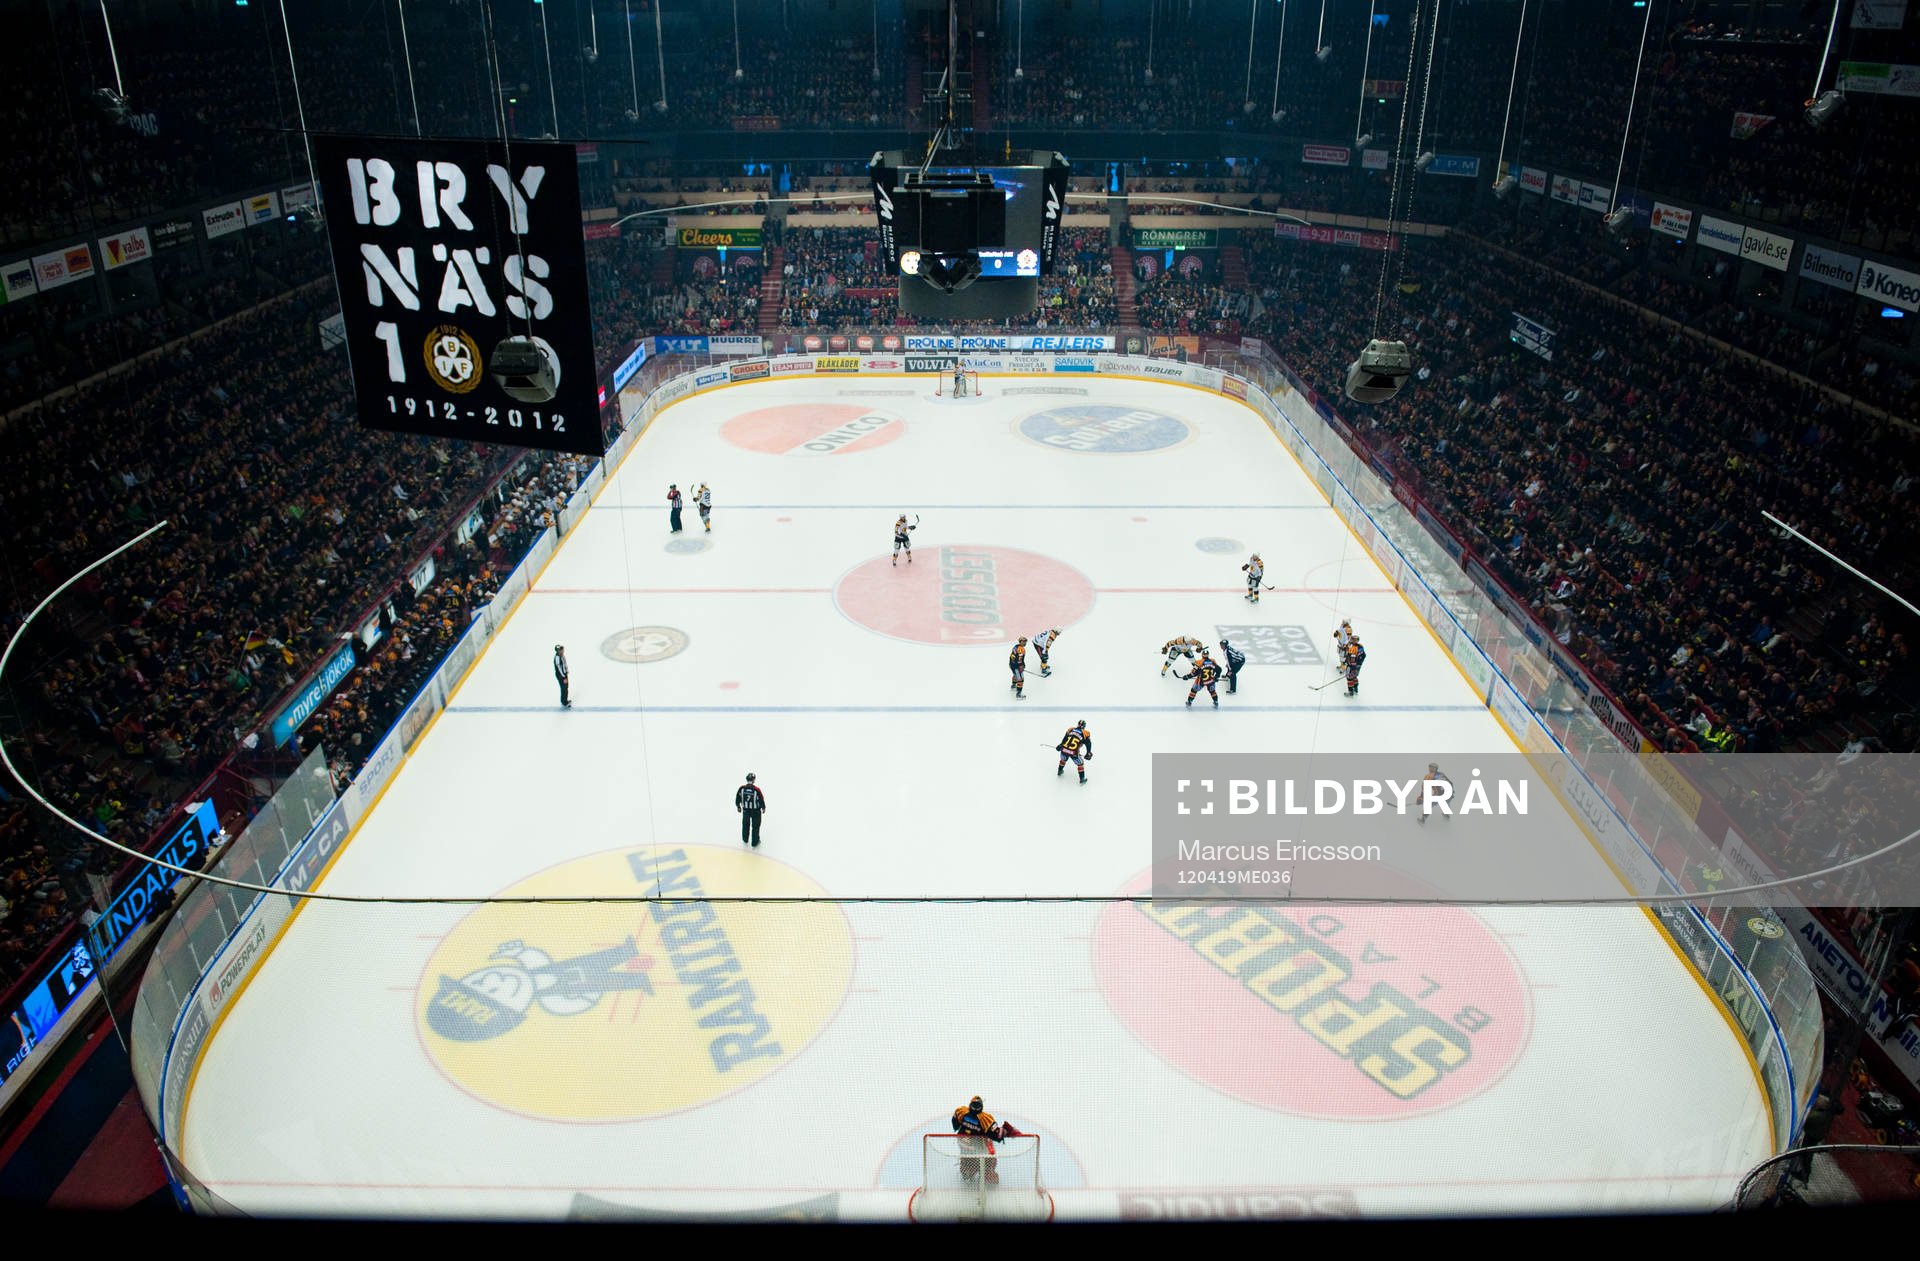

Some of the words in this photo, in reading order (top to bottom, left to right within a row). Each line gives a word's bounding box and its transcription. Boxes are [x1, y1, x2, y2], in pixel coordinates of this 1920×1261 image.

[346, 158, 545, 234] BRY
[682, 228, 733, 245] Cheers
[1142, 230, 1206, 240] RÖNNGREN
[1744, 235, 1788, 260] gavle.se
[1804, 253, 1853, 283] Bilmetro
[360, 244, 553, 319] NÄS
[908, 337, 954, 349] PROLINE
[961, 337, 1006, 348] PROLINE
[1032, 337, 1104, 349] REJLERS
[817, 358, 859, 368] BLÅKLÄDER
[907, 359, 955, 369] VOLVIA
[966, 358, 1001, 368] ViaCon
[1055, 357, 1094, 365] SANDVIK
[805, 414, 889, 452] ONICO
[1064, 736, 1080, 750] 15
[92, 829, 198, 960] LINDAHLS
[219, 925, 268, 992] POWERPLAY
[626, 848, 784, 1074] RAMIRENT
